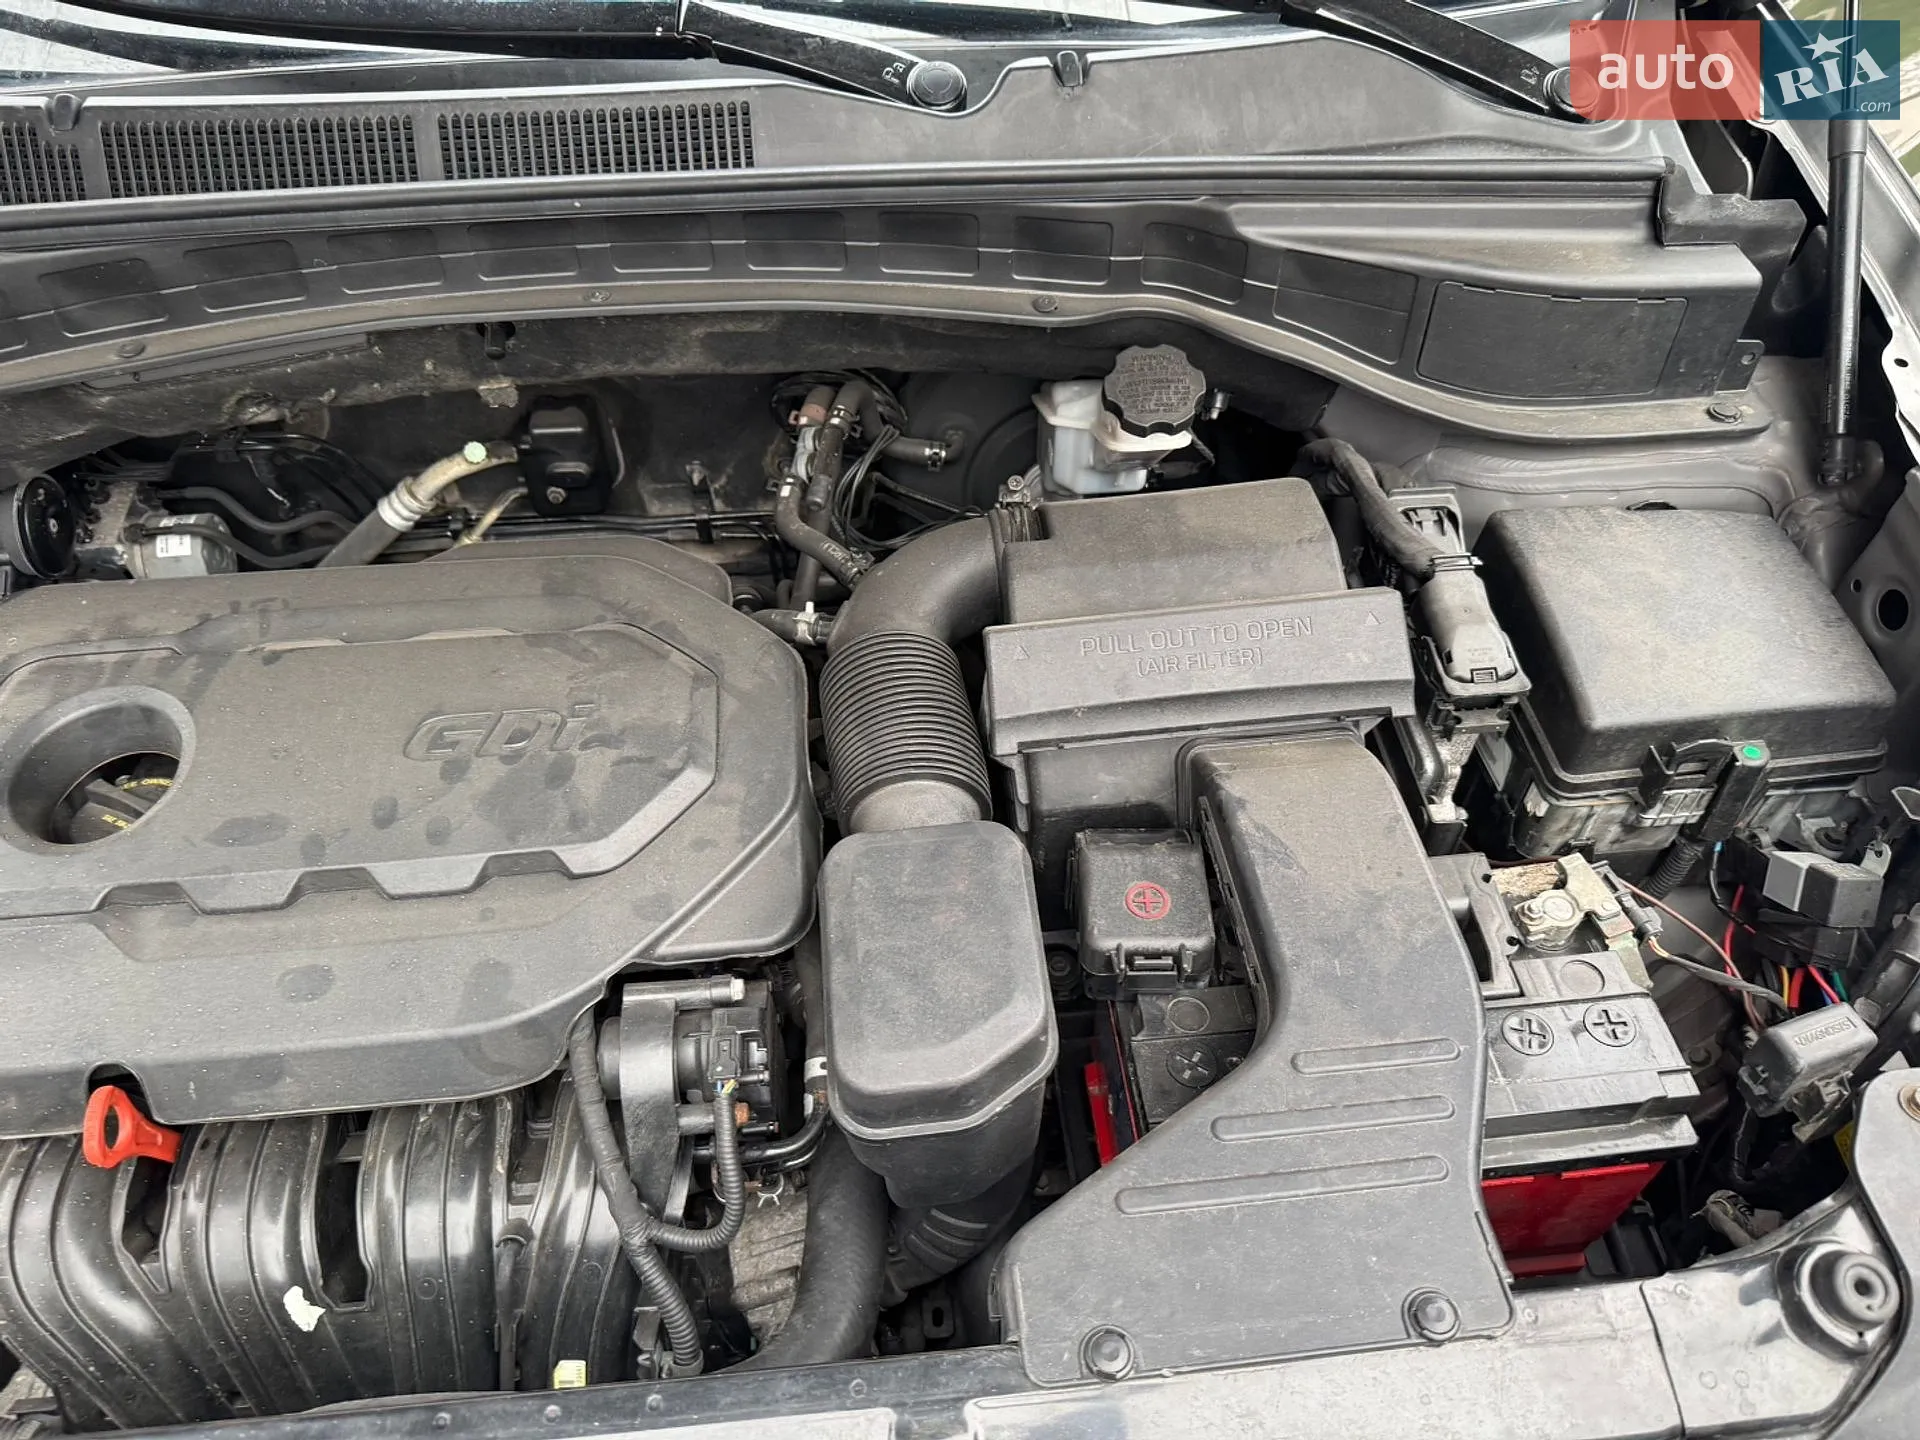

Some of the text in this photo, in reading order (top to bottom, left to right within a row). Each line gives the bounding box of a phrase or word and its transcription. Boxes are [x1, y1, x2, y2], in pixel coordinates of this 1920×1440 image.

[1080, 615, 1314, 657] PULL OUT TO OPEN
[1136, 646, 1264, 678] (AIR FILTER)
[402, 703, 597, 762] GDi
